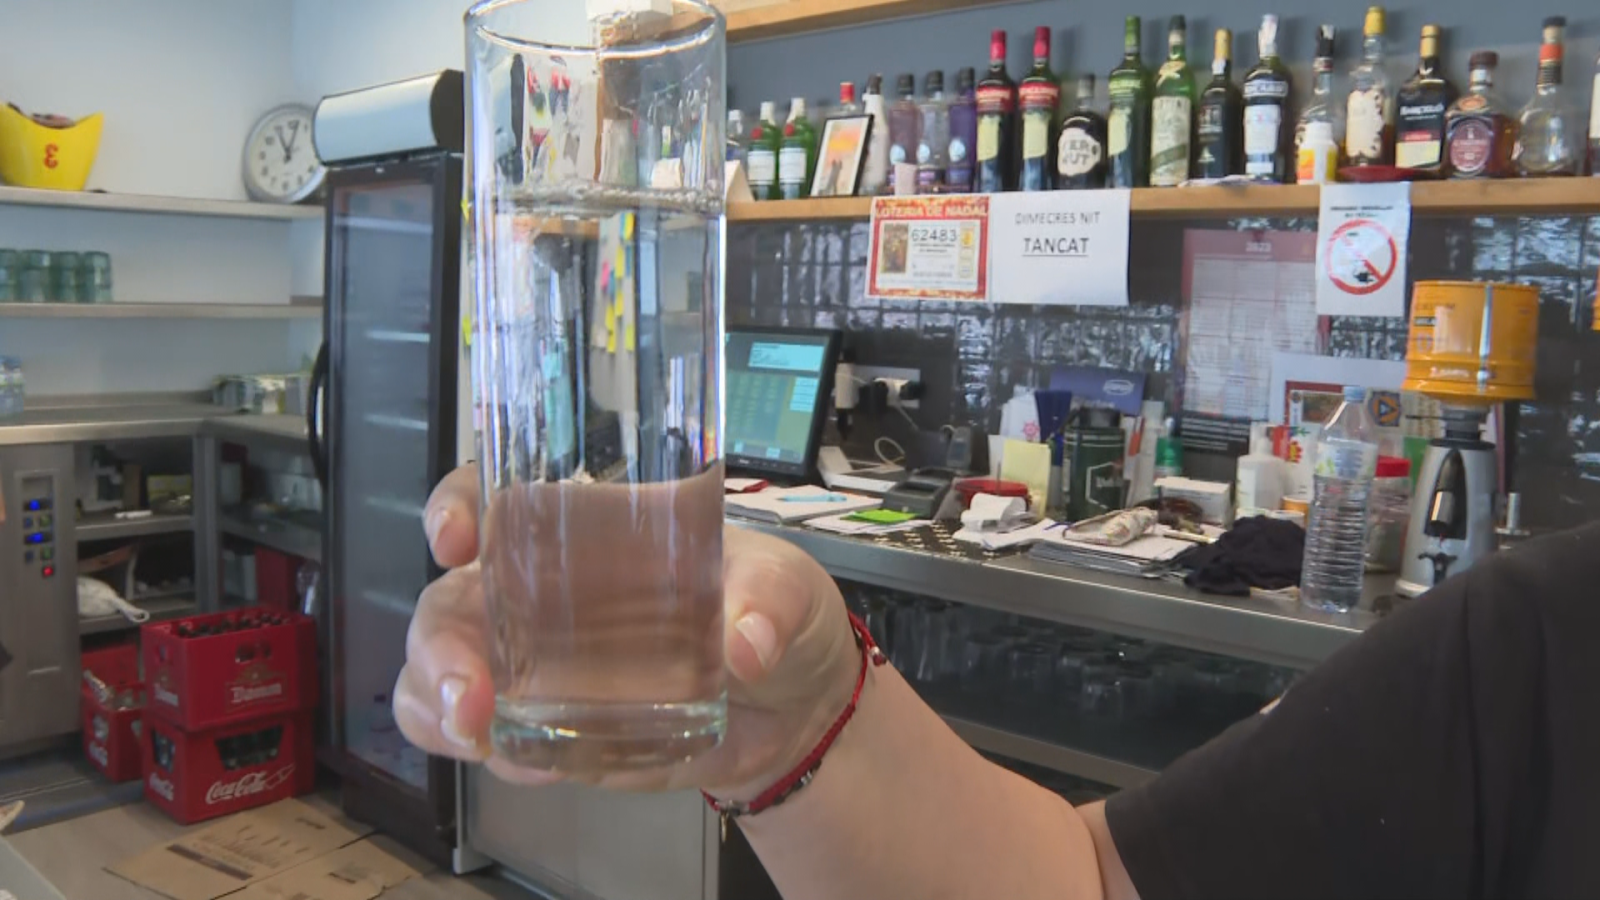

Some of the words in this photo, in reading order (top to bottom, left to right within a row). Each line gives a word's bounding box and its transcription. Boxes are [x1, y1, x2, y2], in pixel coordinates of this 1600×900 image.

[1015, 212, 1076, 224] DIMECRES
[1080, 211, 1101, 224] NIT
[912, 228, 957, 242] 62483
[1023, 237, 1090, 254] TANCAT
